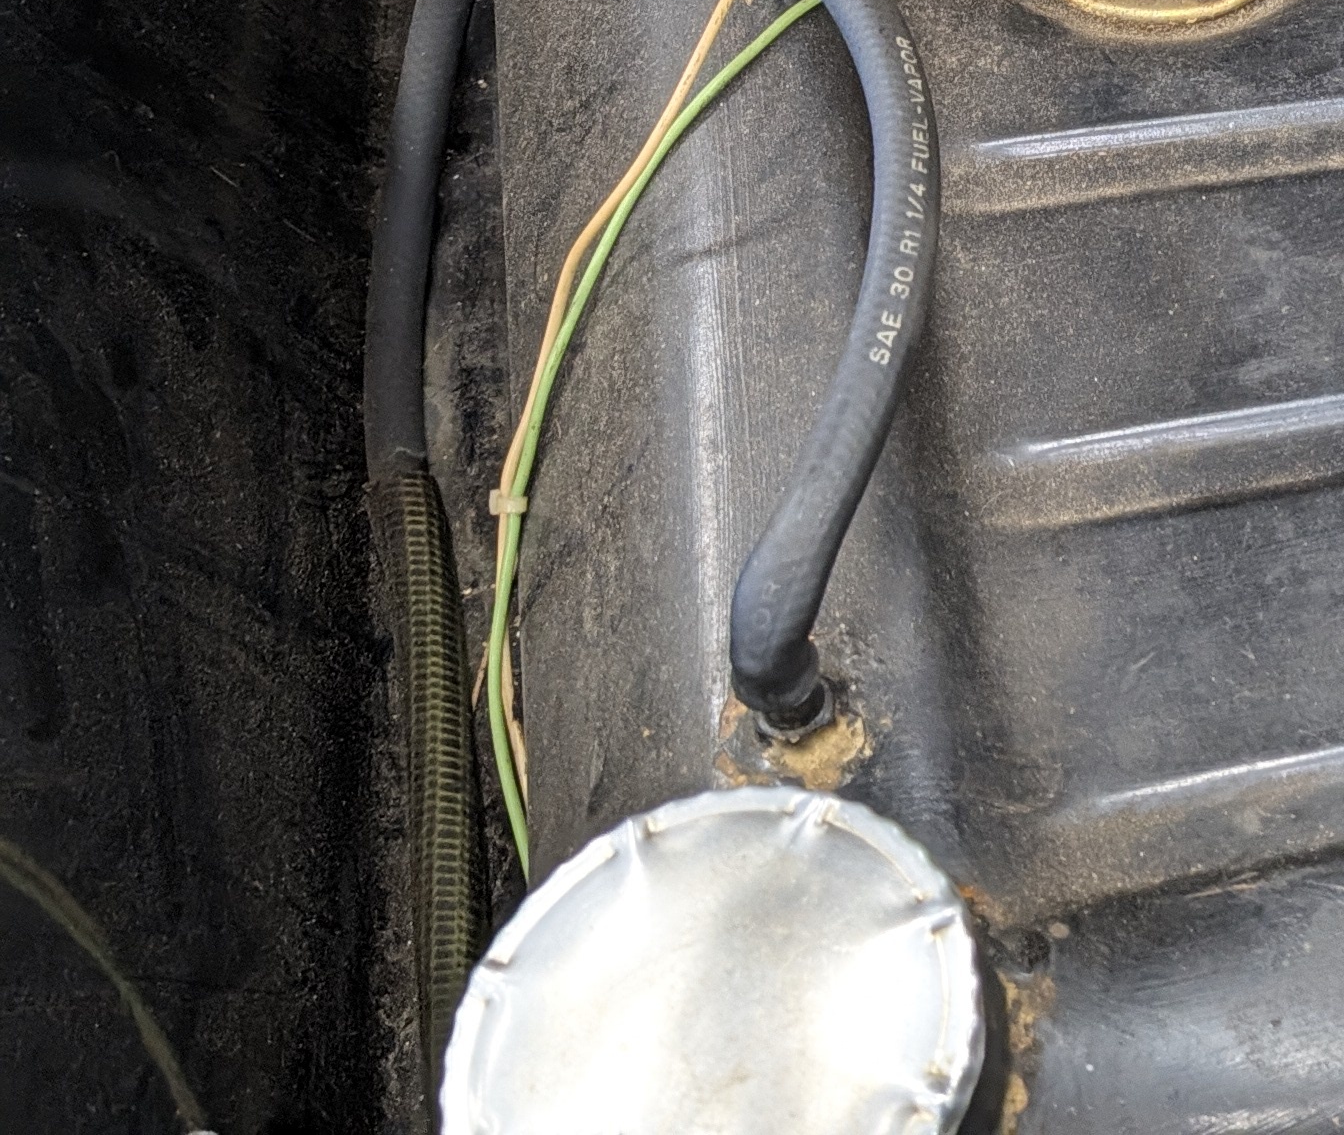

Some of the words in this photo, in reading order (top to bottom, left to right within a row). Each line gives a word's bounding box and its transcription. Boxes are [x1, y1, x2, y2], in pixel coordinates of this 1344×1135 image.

[895, 36, 930, 173] FUEL-VAPOR
[905, 183, 927, 219] 1/4
[898, 231, 922, 256] R1
[889, 266, 914, 299] 30
[868, 310, 904, 365] SAE
